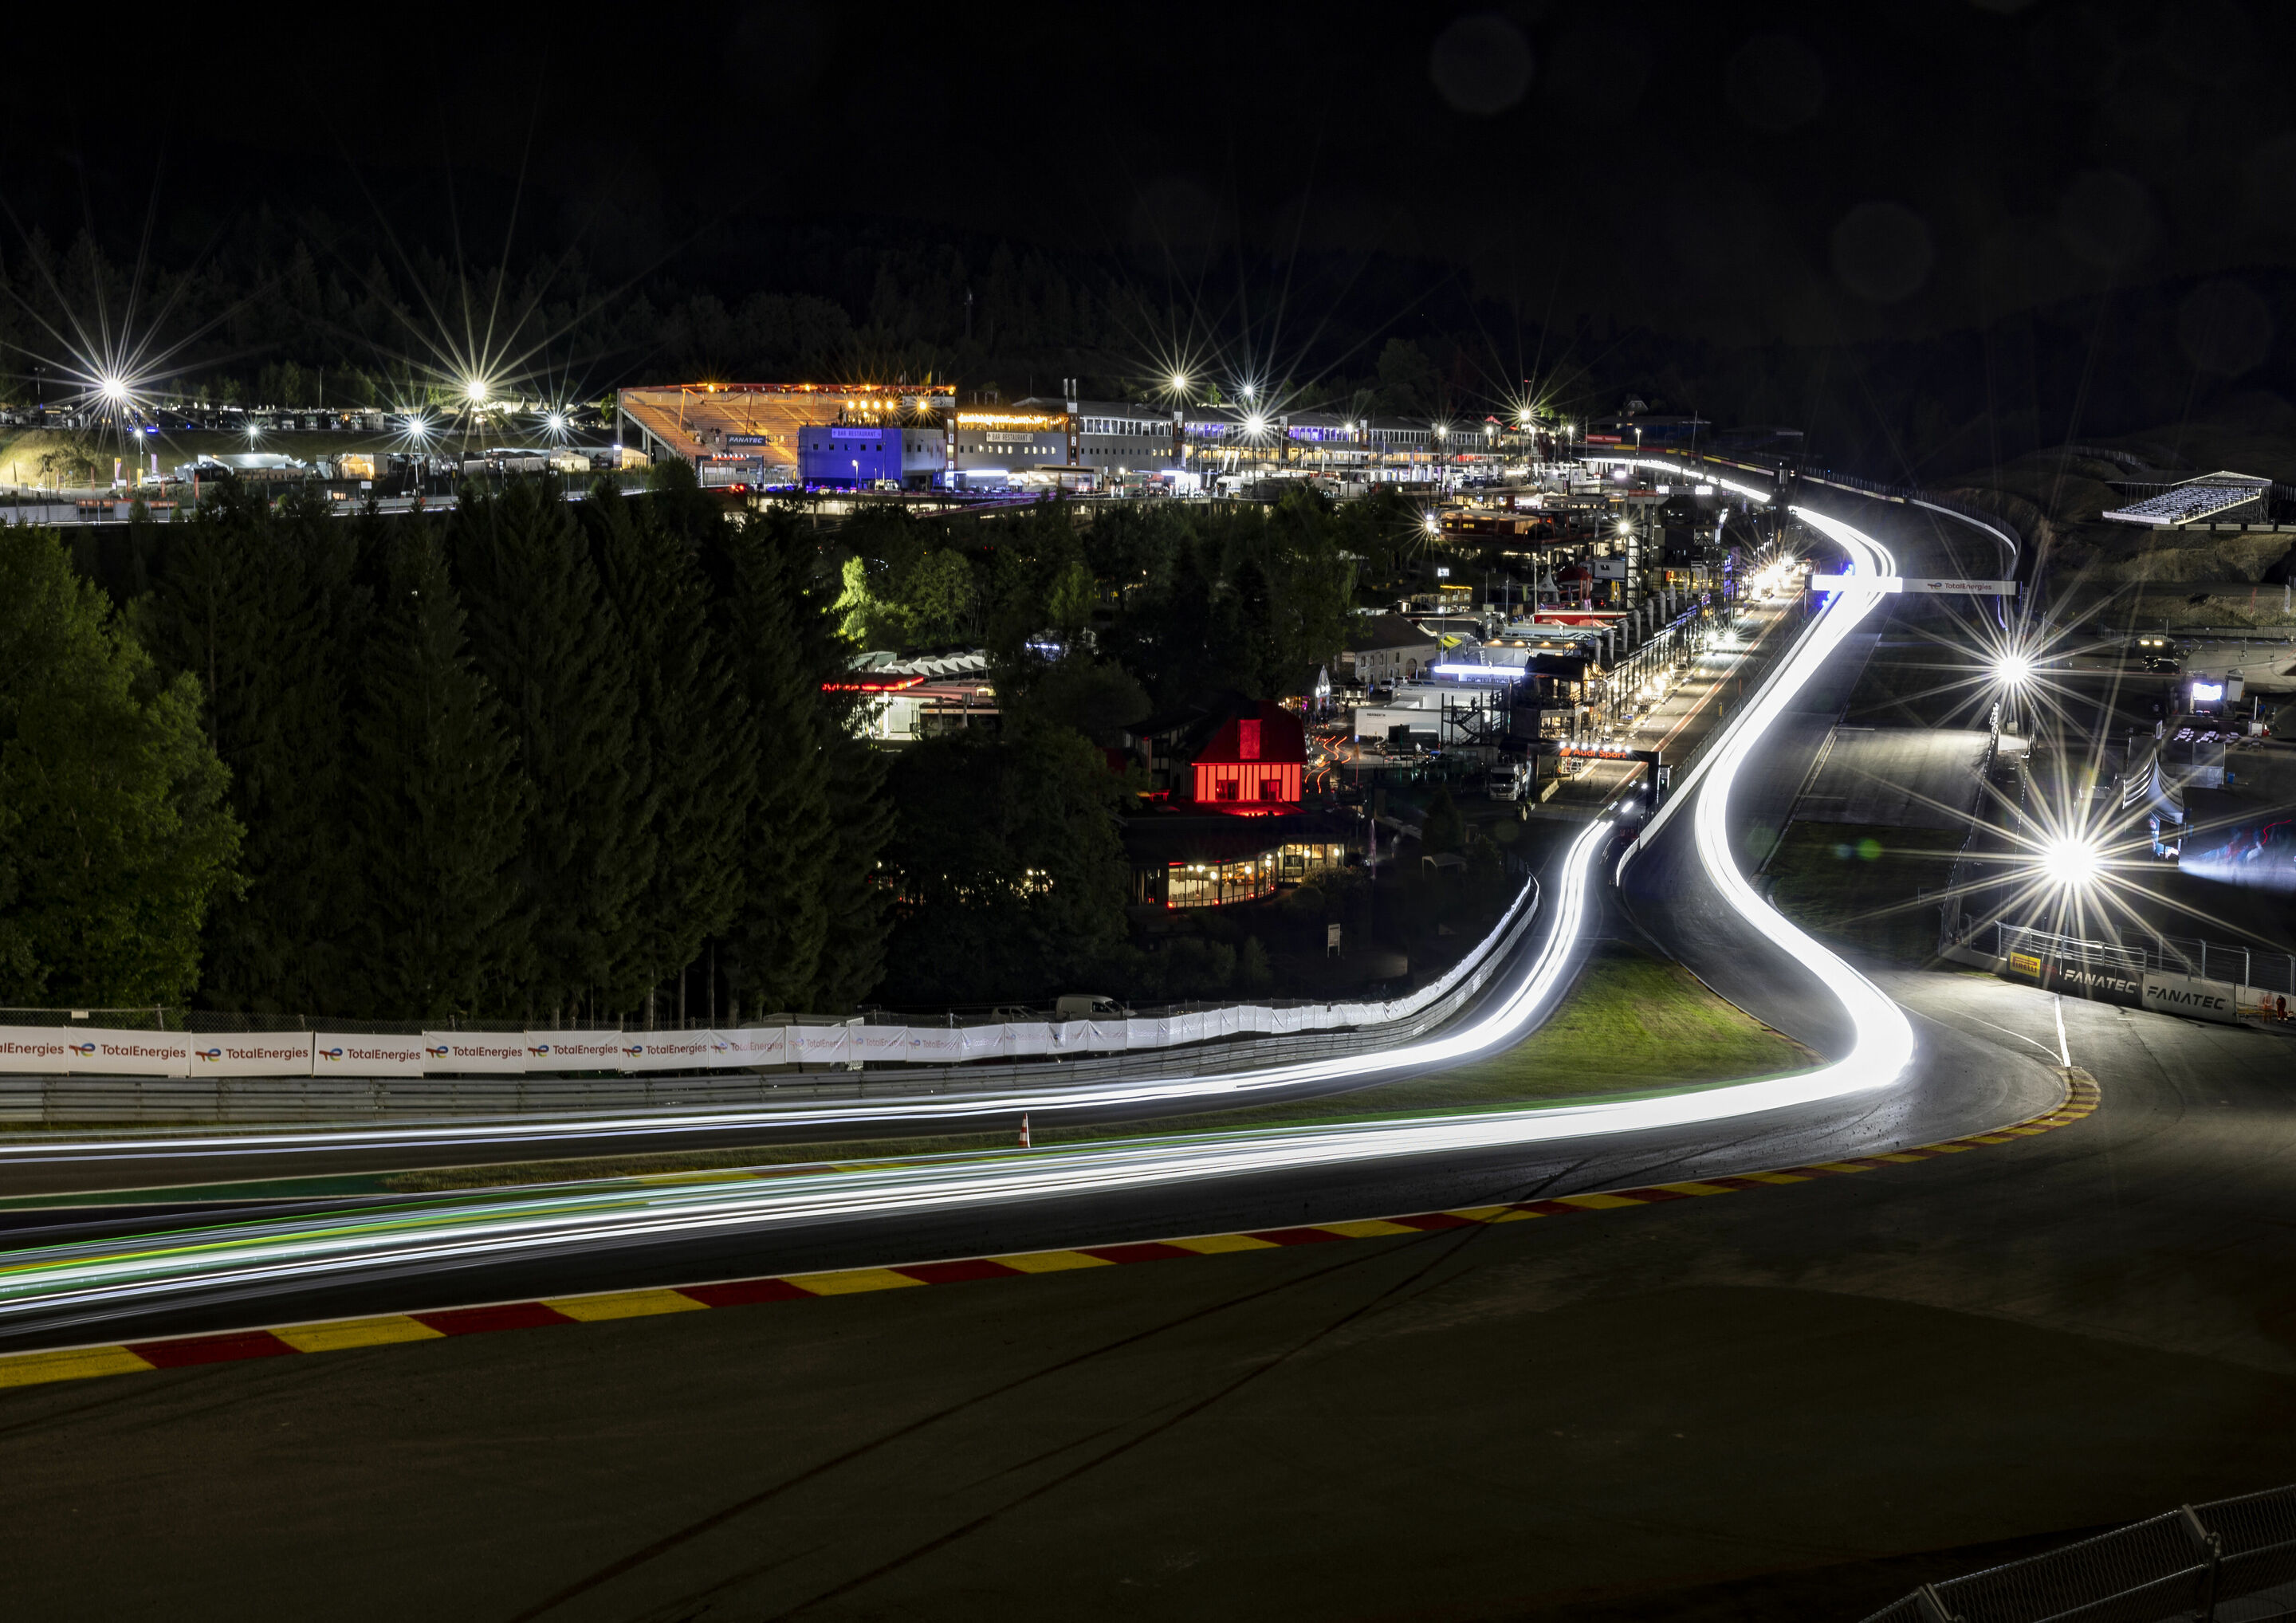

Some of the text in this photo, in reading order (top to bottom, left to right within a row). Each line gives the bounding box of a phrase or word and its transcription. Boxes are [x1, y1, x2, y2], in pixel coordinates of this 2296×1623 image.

[1002, 433, 1028, 442] RESTAURANT
[1944, 582, 1992, 591] TotalEnergies
[1573, 748, 1626, 759] Audi Sport
[2012, 956, 2038, 973] PIRELLI
[2063, 969, 2137, 994] FANATEC
[2146, 985, 2227, 1010] FANATEC
[100, 1043, 187, 1060] TotalEnergies
[452, 1046, 523, 1059] TotalEnergies
[552, 1044, 619, 1056] TotalEnergies
[646, 1043, 707, 1055] TotalEnergies
[730, 1040, 784, 1052] TotalEnergies
[226, 1047, 309, 1061] TotalEnergies
[347, 1047, 421, 1063] TotalEnergies
